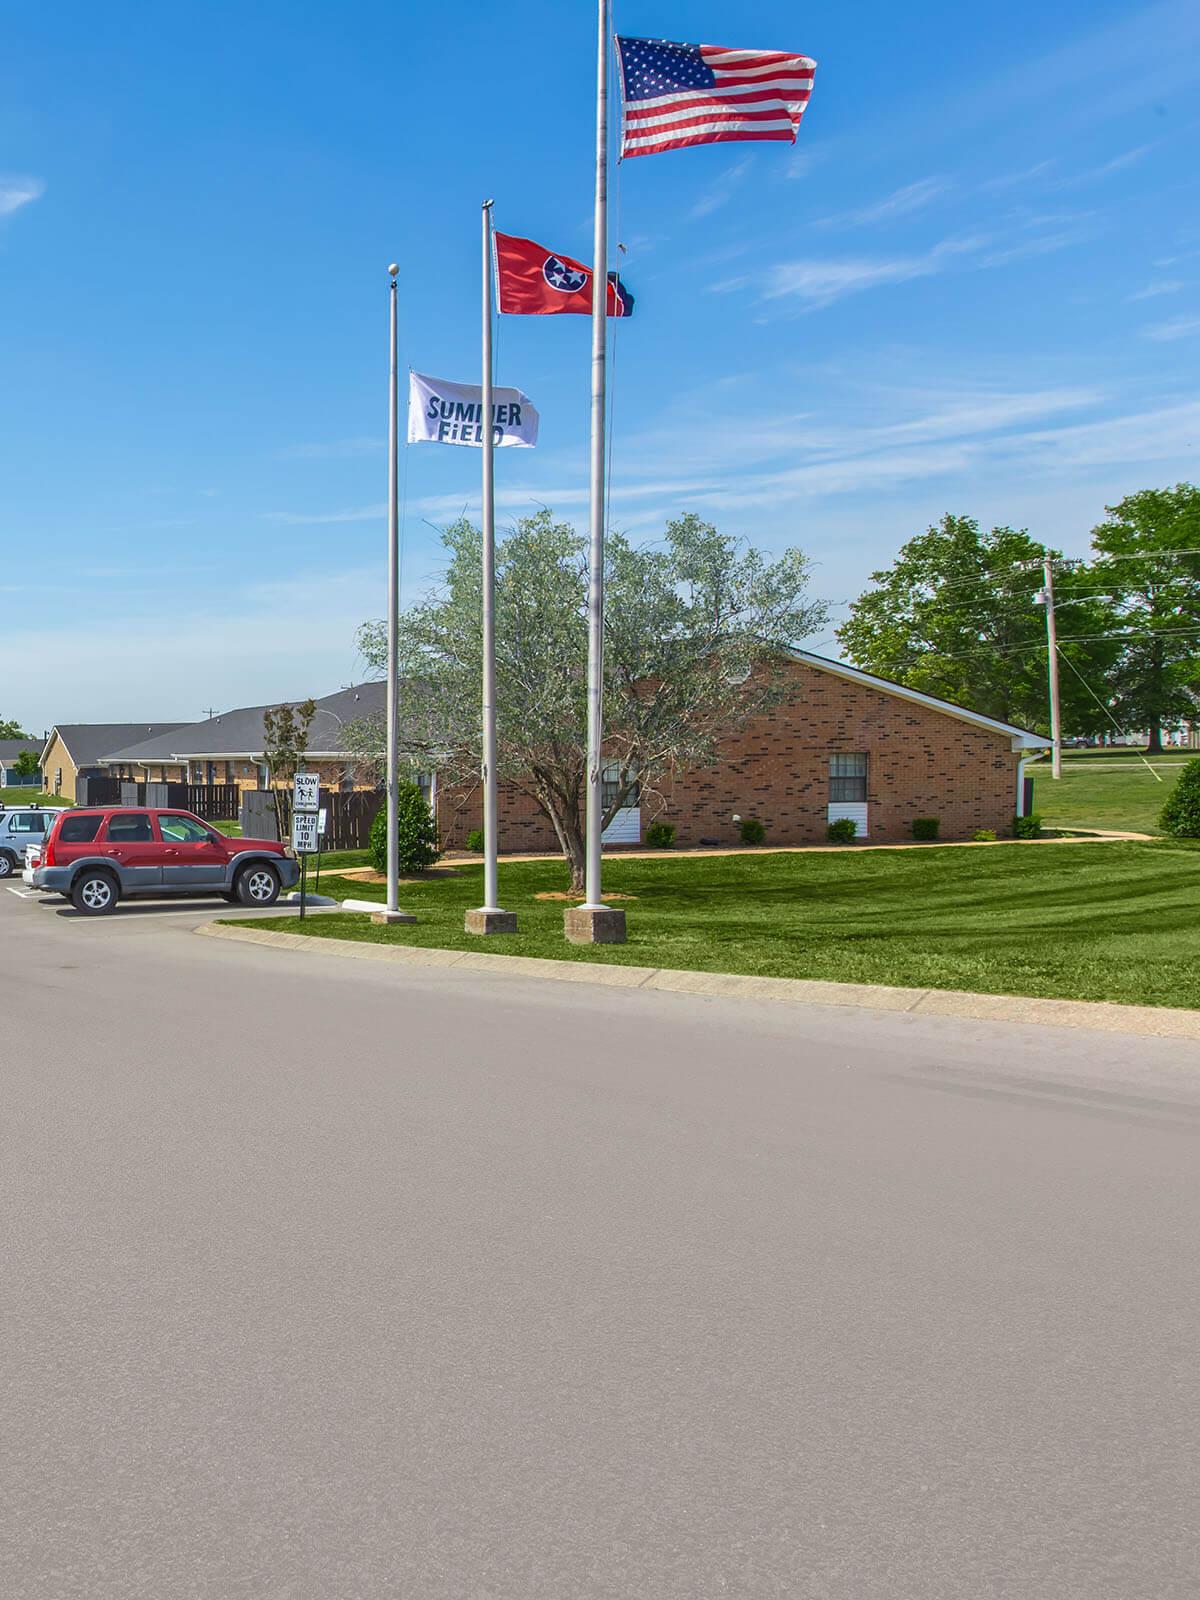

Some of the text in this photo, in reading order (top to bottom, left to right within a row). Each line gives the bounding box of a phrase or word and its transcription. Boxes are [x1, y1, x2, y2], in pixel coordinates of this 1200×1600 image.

[296, 777, 316, 785] SLOW
[296, 816, 316, 824] SPEED
[301, 832, 309, 840] 10
